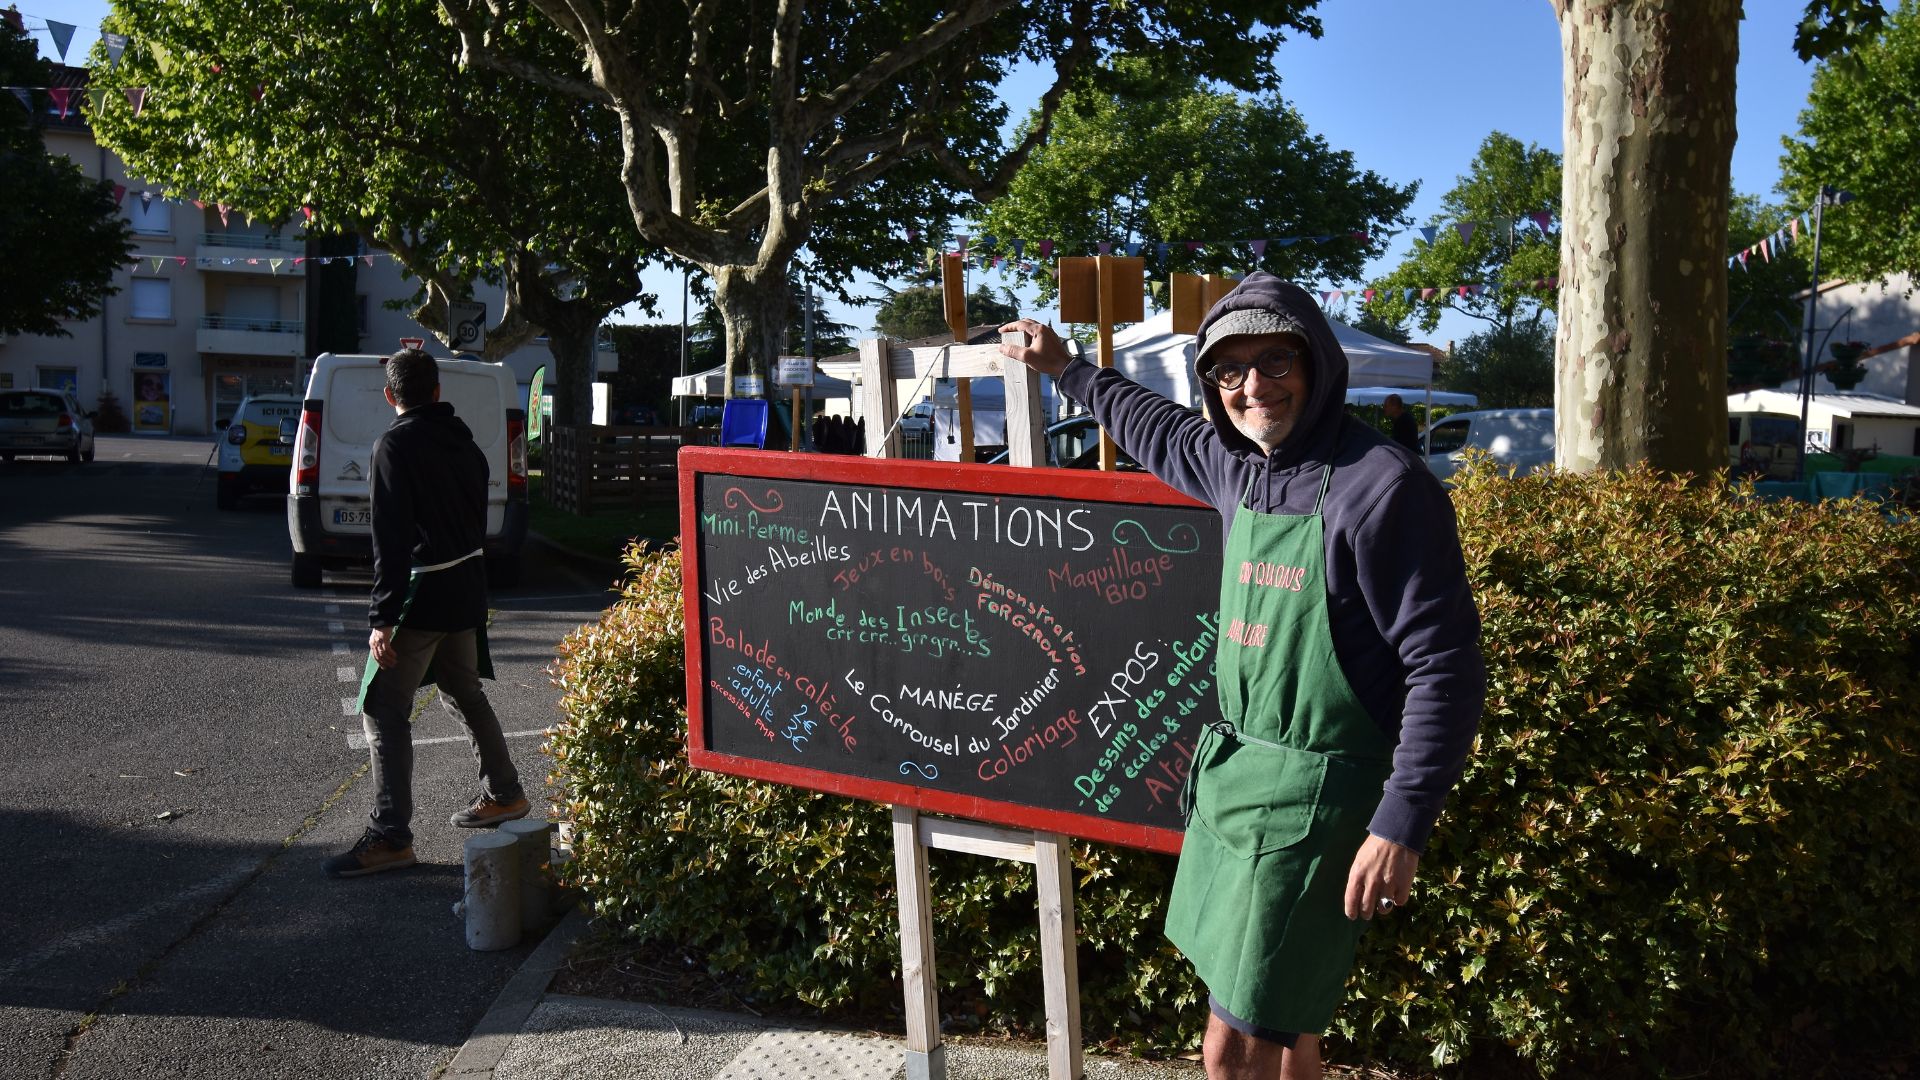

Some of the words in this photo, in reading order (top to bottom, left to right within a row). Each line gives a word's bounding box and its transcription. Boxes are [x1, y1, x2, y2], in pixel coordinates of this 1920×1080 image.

[461, 327, 475, 337] 30
[262, 408, 275, 416] ICI
[276, 407, 290, 416] ON
[704, 577, 742, 605] Vie
[745, 565, 768, 585] des
[768, 535, 851, 573] Abeilles
[833, 549, 884, 592] Jeux
[890, 547, 914, 562] en
[922, 552, 955, 601] bois
[1048, 546, 1174, 597] Maquillage
[1105, 580, 1147, 605] BIO
[710, 616, 777, 669] Balade
[776, 666, 791, 681] en
[789, 597, 846, 627] Monde
[859, 609, 889, 629] des
[896, 605, 992, 657] Insectes
[710, 680, 751, 718] accessible
[754, 718, 775, 742] PMR
[845, 668, 865, 695] Le
[870, 694, 960, 756] Carrousel
[968, 736, 991, 754] du
[992, 667, 1060, 741] Jardinier
[1135, 689, 1166, 719] des
[978, 709, 1082, 781] Coloriage
[1095, 784, 1121, 813] des
[1122, 732, 1168, 779] écoles
[1162, 715, 1181, 734] &
[1176, 697, 1198, 715] de
[1189, 679, 1210, 697] la
